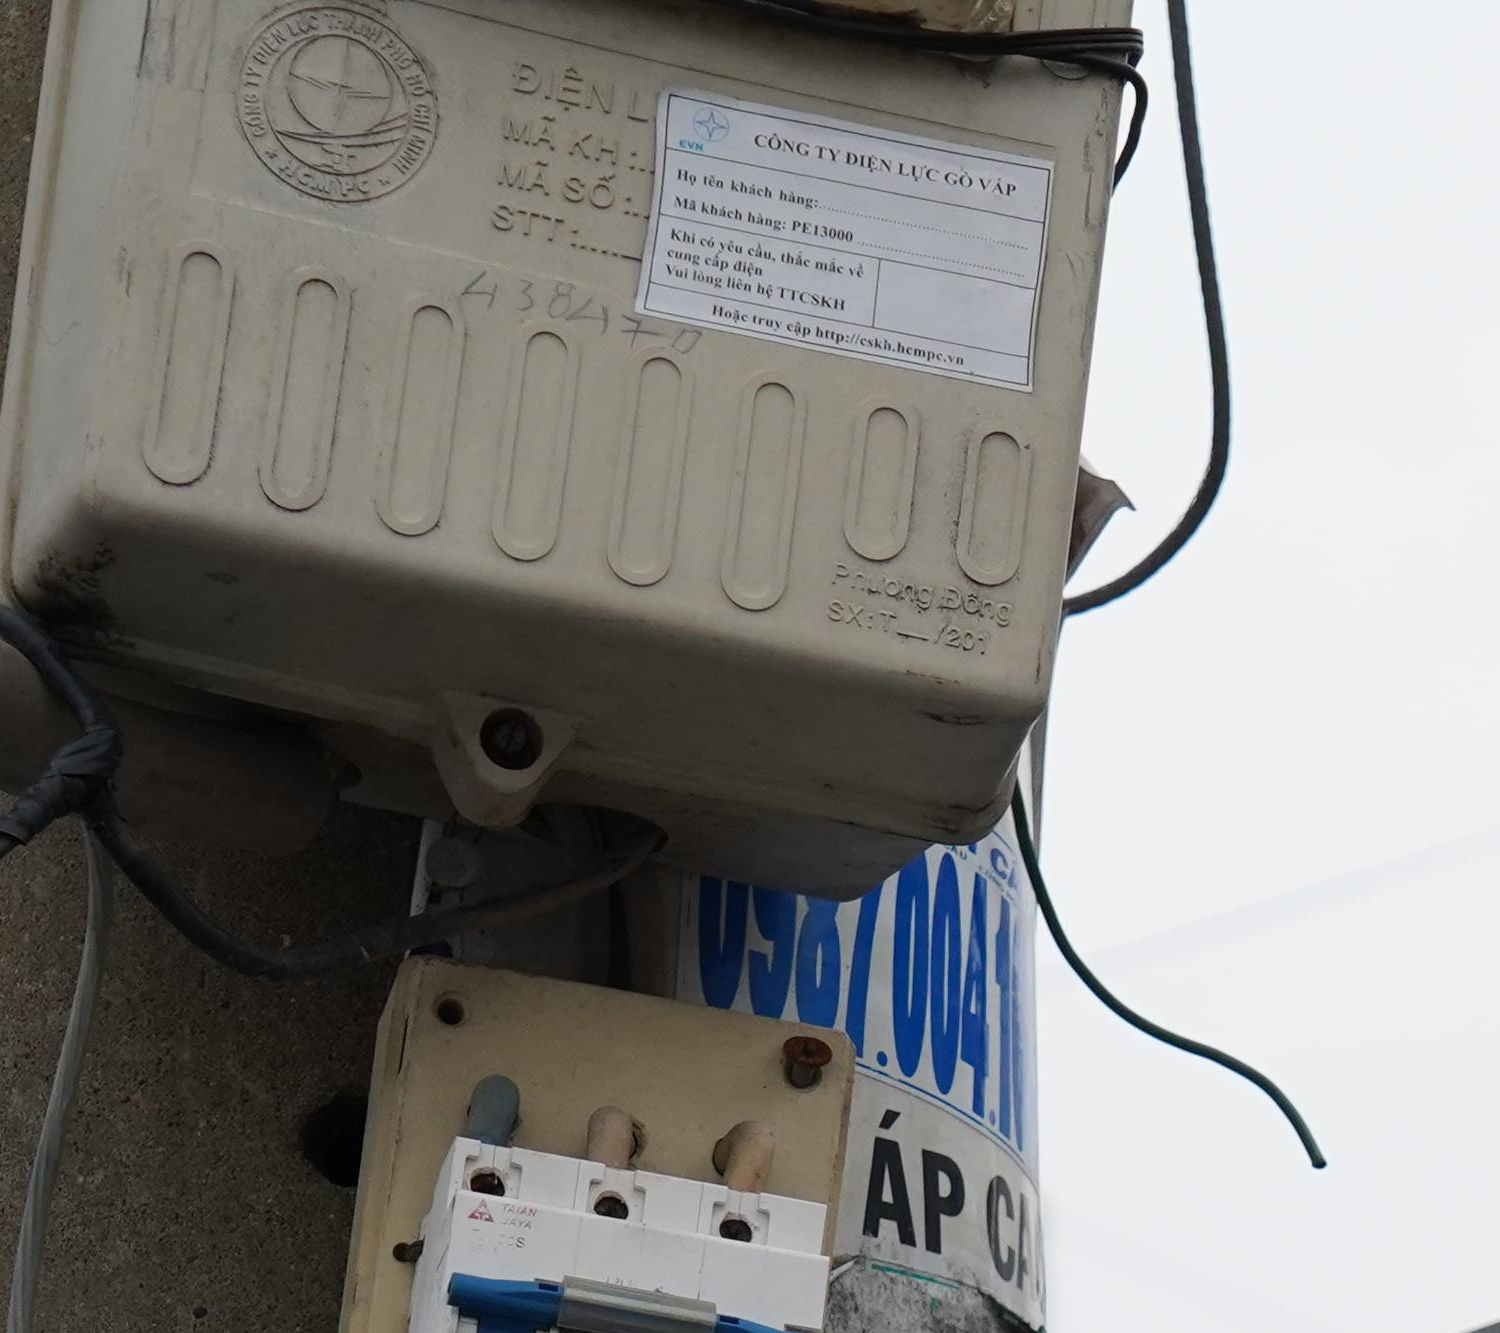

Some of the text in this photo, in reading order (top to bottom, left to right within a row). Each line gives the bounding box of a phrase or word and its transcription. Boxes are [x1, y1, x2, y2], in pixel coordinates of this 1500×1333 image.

[511, 62, 616, 115] ĐIỆN
[391, 134, 426, 175] MINH
[502, 114, 557, 152] MÃ
[678, 138, 705, 152] EVN
[497, 160, 550, 197] MÃ
[754, 132, 810, 157] CÔNG
[814, 145, 843, 163] TY
[845, 151, 892, 173] ĐIỆN
[898, 162, 940, 183] LỰC
[944, 168, 973, 189] GÒ
[676, 167, 697, 186] Họ
[703, 174, 724, 189] tên
[730, 179, 773, 199] khách
[673, 195, 854, 243] Mã khách hàng: PE13000
[667, 249, 764, 277] cung cấp điện
[670, 227, 865, 279] Khi có yêu cầu, thắc mắc về
[665, 263, 846, 312] Vui lòng liên hệ TTCSKH
[712, 304, 965, 367] Hoặc truy cập http://cskh.hcmpc.vn
